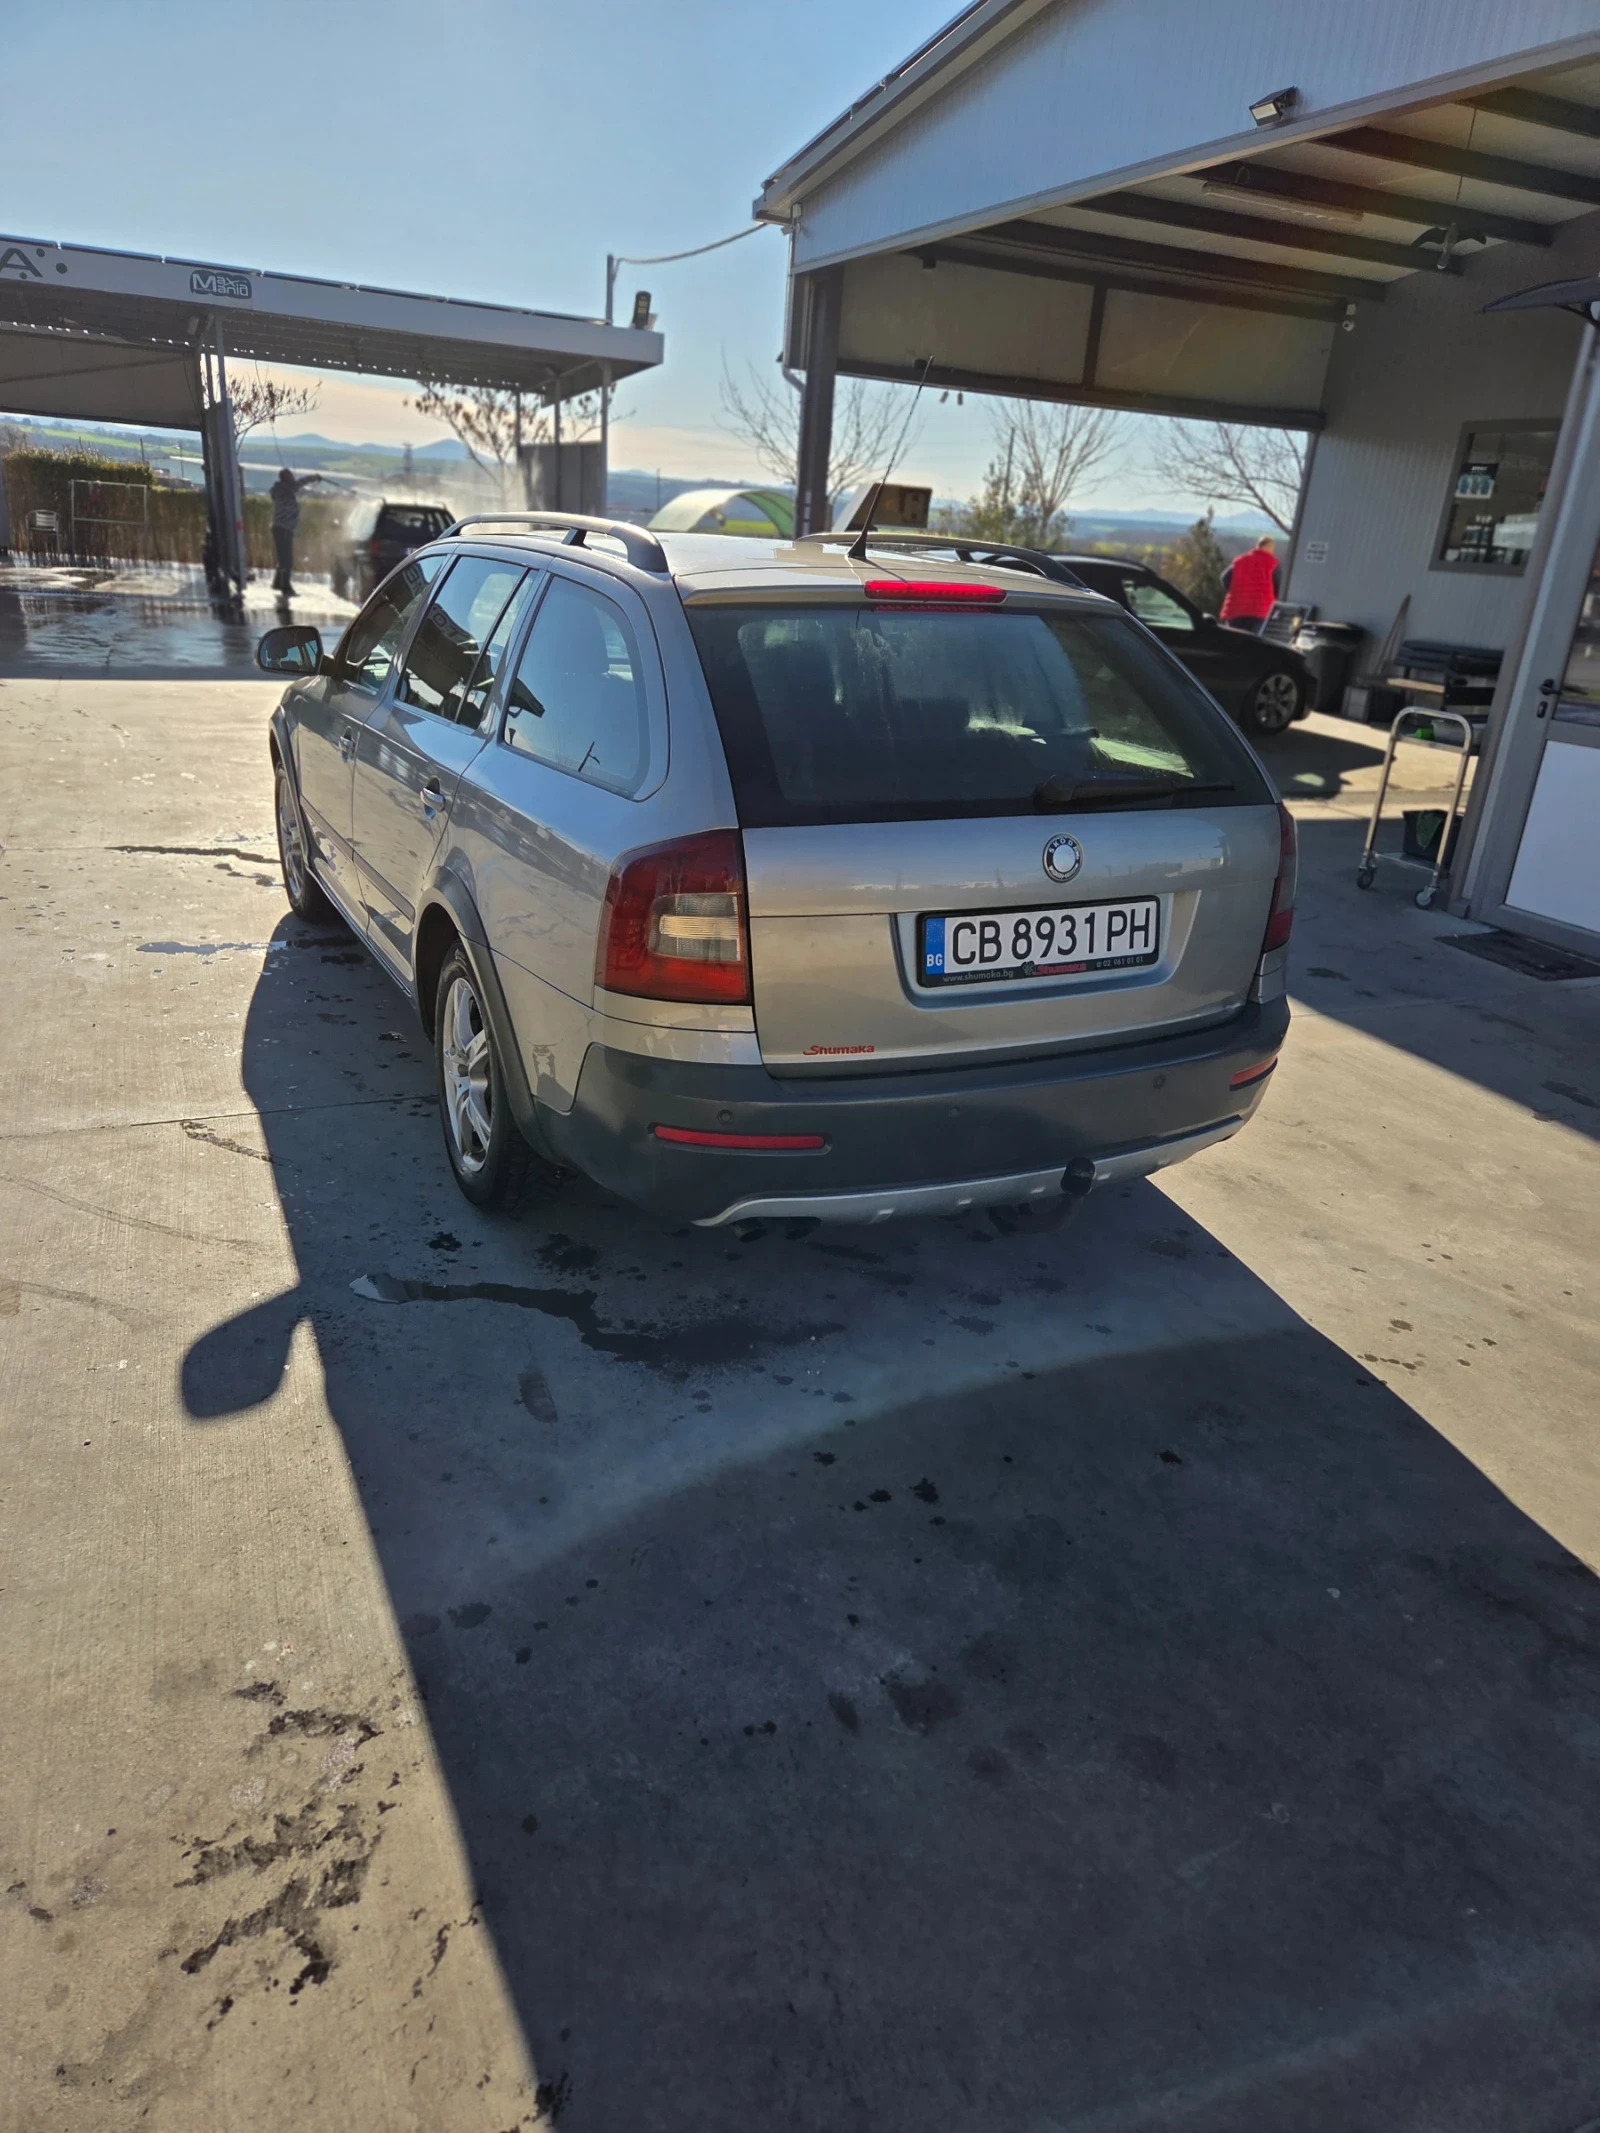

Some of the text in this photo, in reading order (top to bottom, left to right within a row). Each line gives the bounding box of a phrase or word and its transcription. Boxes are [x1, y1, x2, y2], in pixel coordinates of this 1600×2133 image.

[952, 908, 1150, 965] CB 8931 PH
[926, 954, 943, 967] BG
[1032, 963, 1087, 976] Shumaka
[943, 970, 1014, 983] www.shumaka.bg
[802, 1044, 875, 1056] Shumaka
